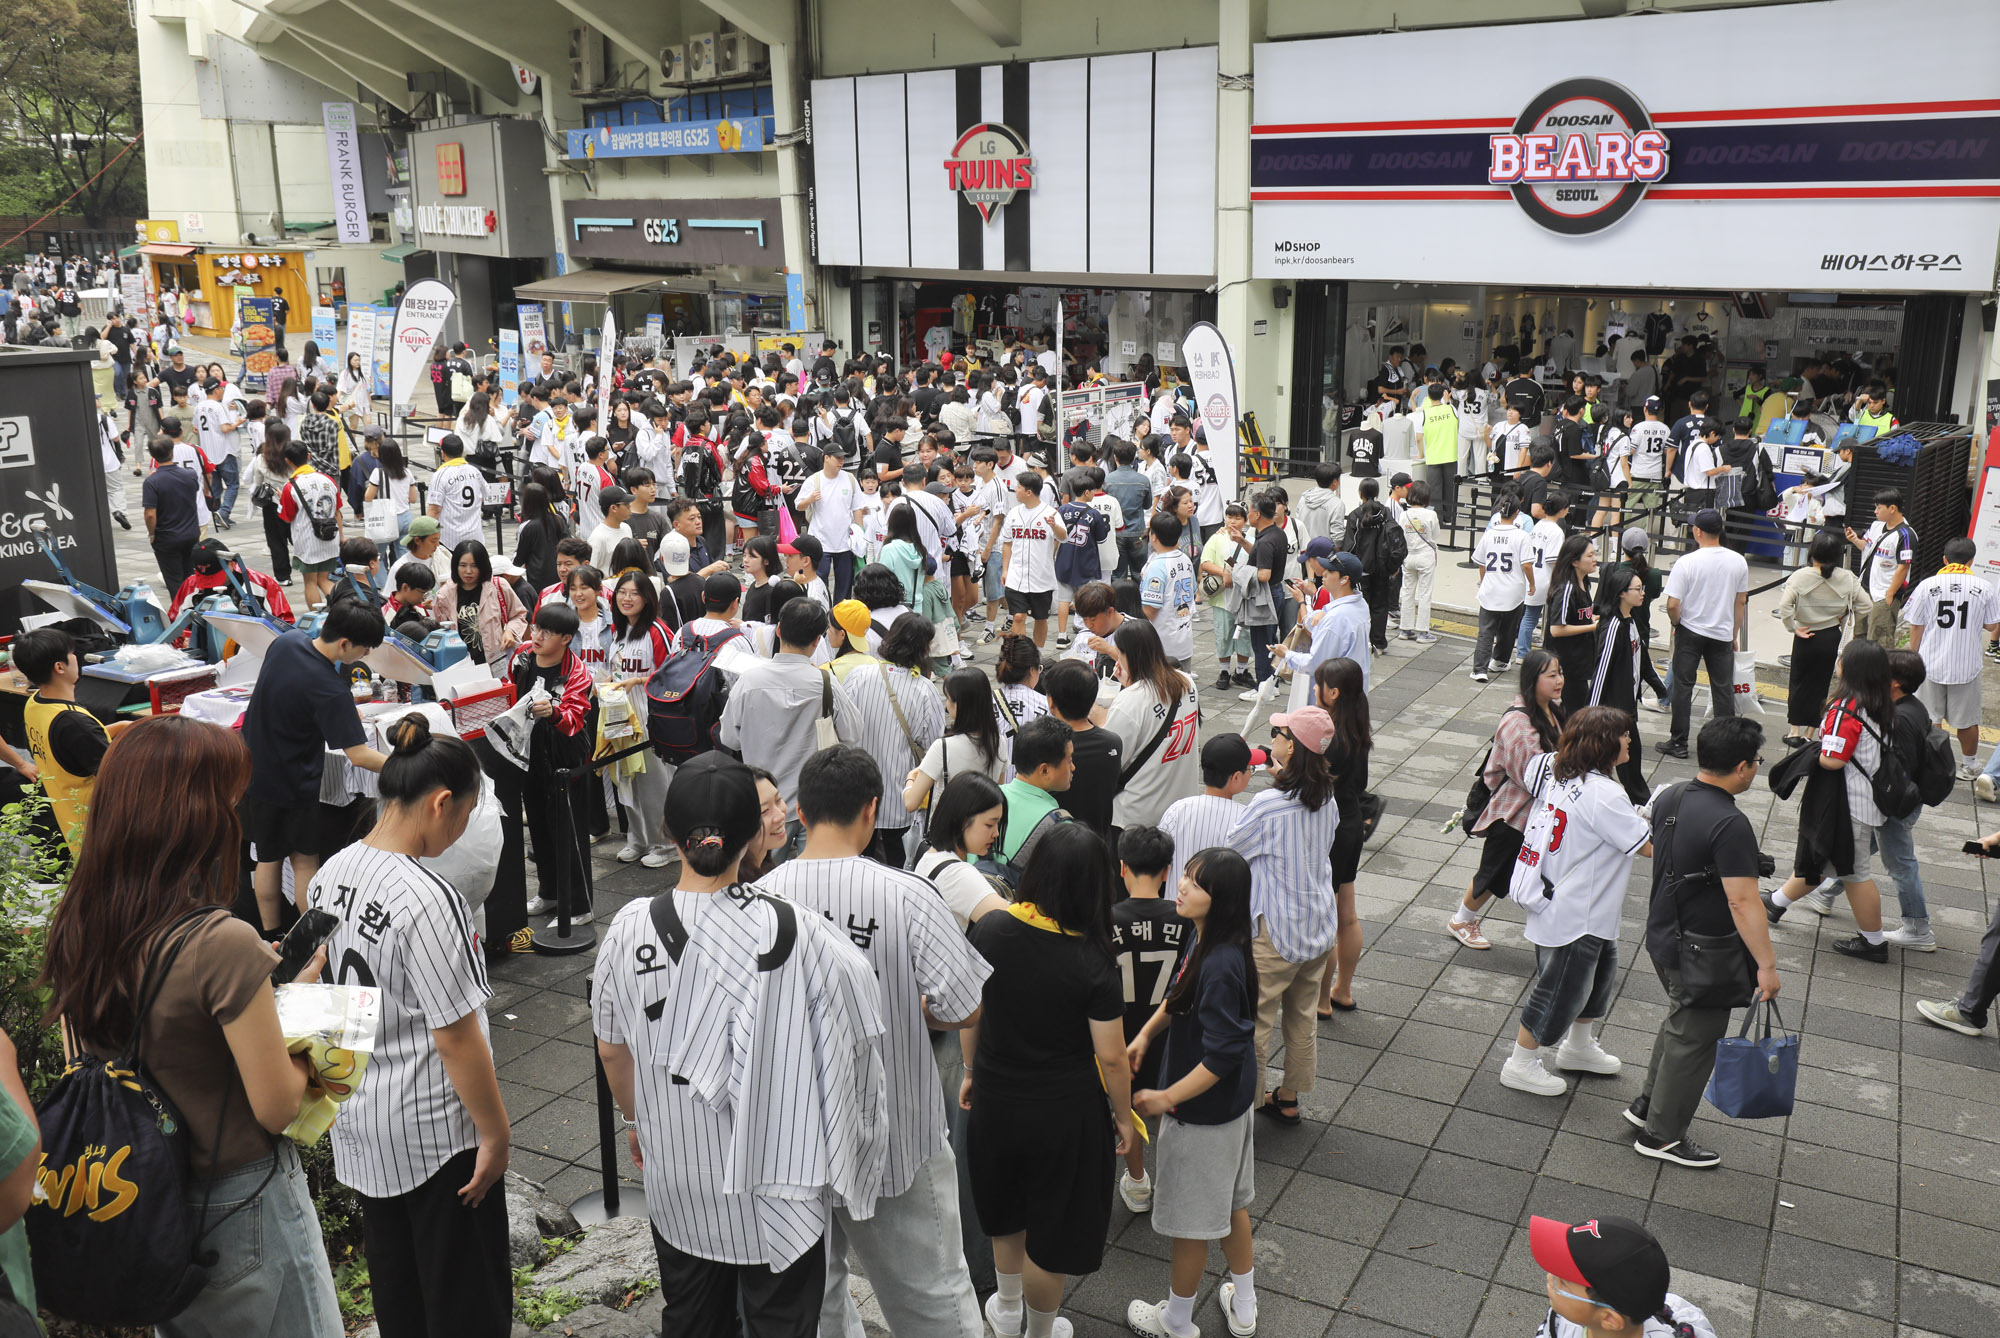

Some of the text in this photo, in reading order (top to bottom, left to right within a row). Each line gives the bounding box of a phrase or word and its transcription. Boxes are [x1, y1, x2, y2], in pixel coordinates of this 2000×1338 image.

[1545, 113, 1615, 127] DOOSAN
[611, 128, 710, 150] 잠실야구장 대표 편의점 GS25
[979, 141, 995, 154] LG
[1489, 130, 1669, 184] BEARS
[1685, 143, 1818, 164] DOOSAN
[1838, 138, 1987, 161] DOOSAN
[1256, 150, 1472, 171] DOOSAN DOOSAN
[336, 131, 360, 238] FRANK BURGER
[943, 158, 1032, 191] TWINS
[976, 193, 1000, 201] SEOUL
[1555, 188, 1599, 202] SEOUL
[443, 206, 487, 237] CHICKEN
[644, 218, 679, 243] GS25
[1275, 241, 1321, 252] MDSHOP
[1274, 254, 1355, 267] inpk.kr/doosanbears
[1820, 253, 1963, 273] 베어스하우스
[405, 298, 449, 311] 매장입구
[406, 310, 444, 319] ENTRANCE
[398, 336, 432, 345] TWINS
[501, 357, 517, 373] 맥주
[200, 415, 209, 431] 2
[1429, 414, 1451, 423] STAFF
[1646, 437, 1662, 453] 13
[448, 475, 467, 485] CHOI
[462, 486, 474, 508] 9
[1486, 552, 1513, 573] 25
[1173, 577, 1194, 606] 25
[1937, 601, 1969, 630] 51
[1161, 710, 1197, 764] 27
[1115, 949, 1178, 1005] 17
